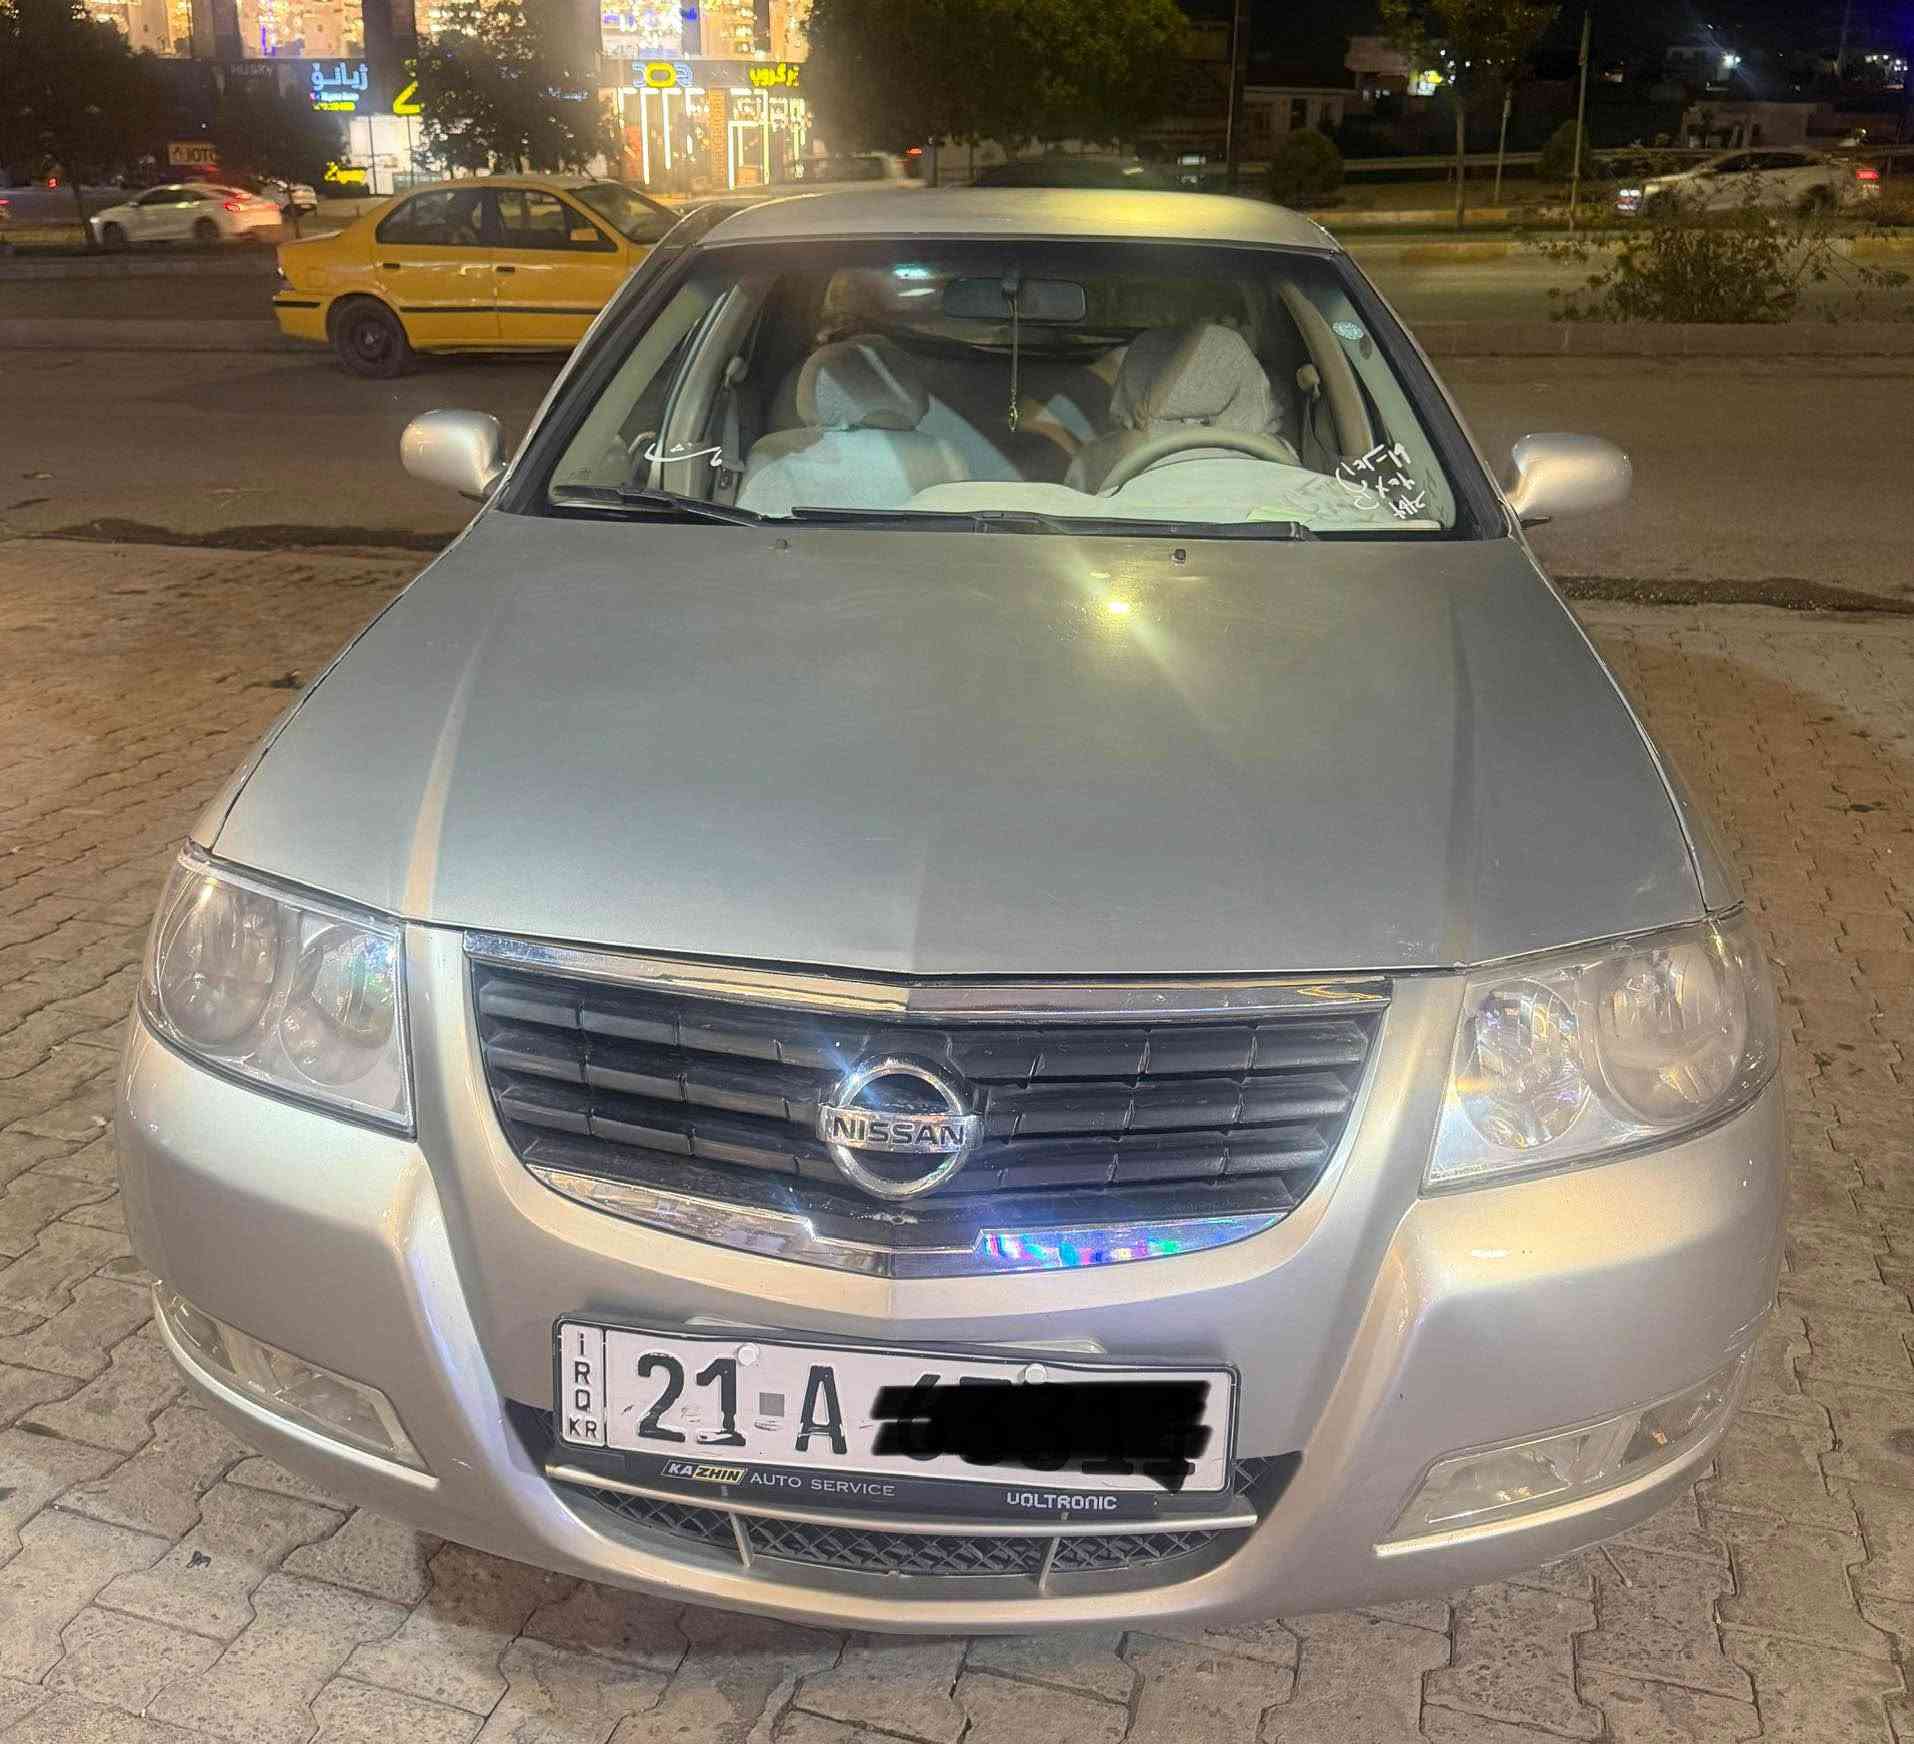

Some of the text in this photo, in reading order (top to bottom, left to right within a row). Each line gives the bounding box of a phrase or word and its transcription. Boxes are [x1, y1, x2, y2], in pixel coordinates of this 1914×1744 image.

[833, 1116, 965, 1145] NISSAN
[637, 1351, 746, 1447] 21
[794, 1364, 848, 1455] A
[569, 1417, 597, 1439] KR
[667, 1462, 897, 1497] KAZHIN AUTO SERVICE
